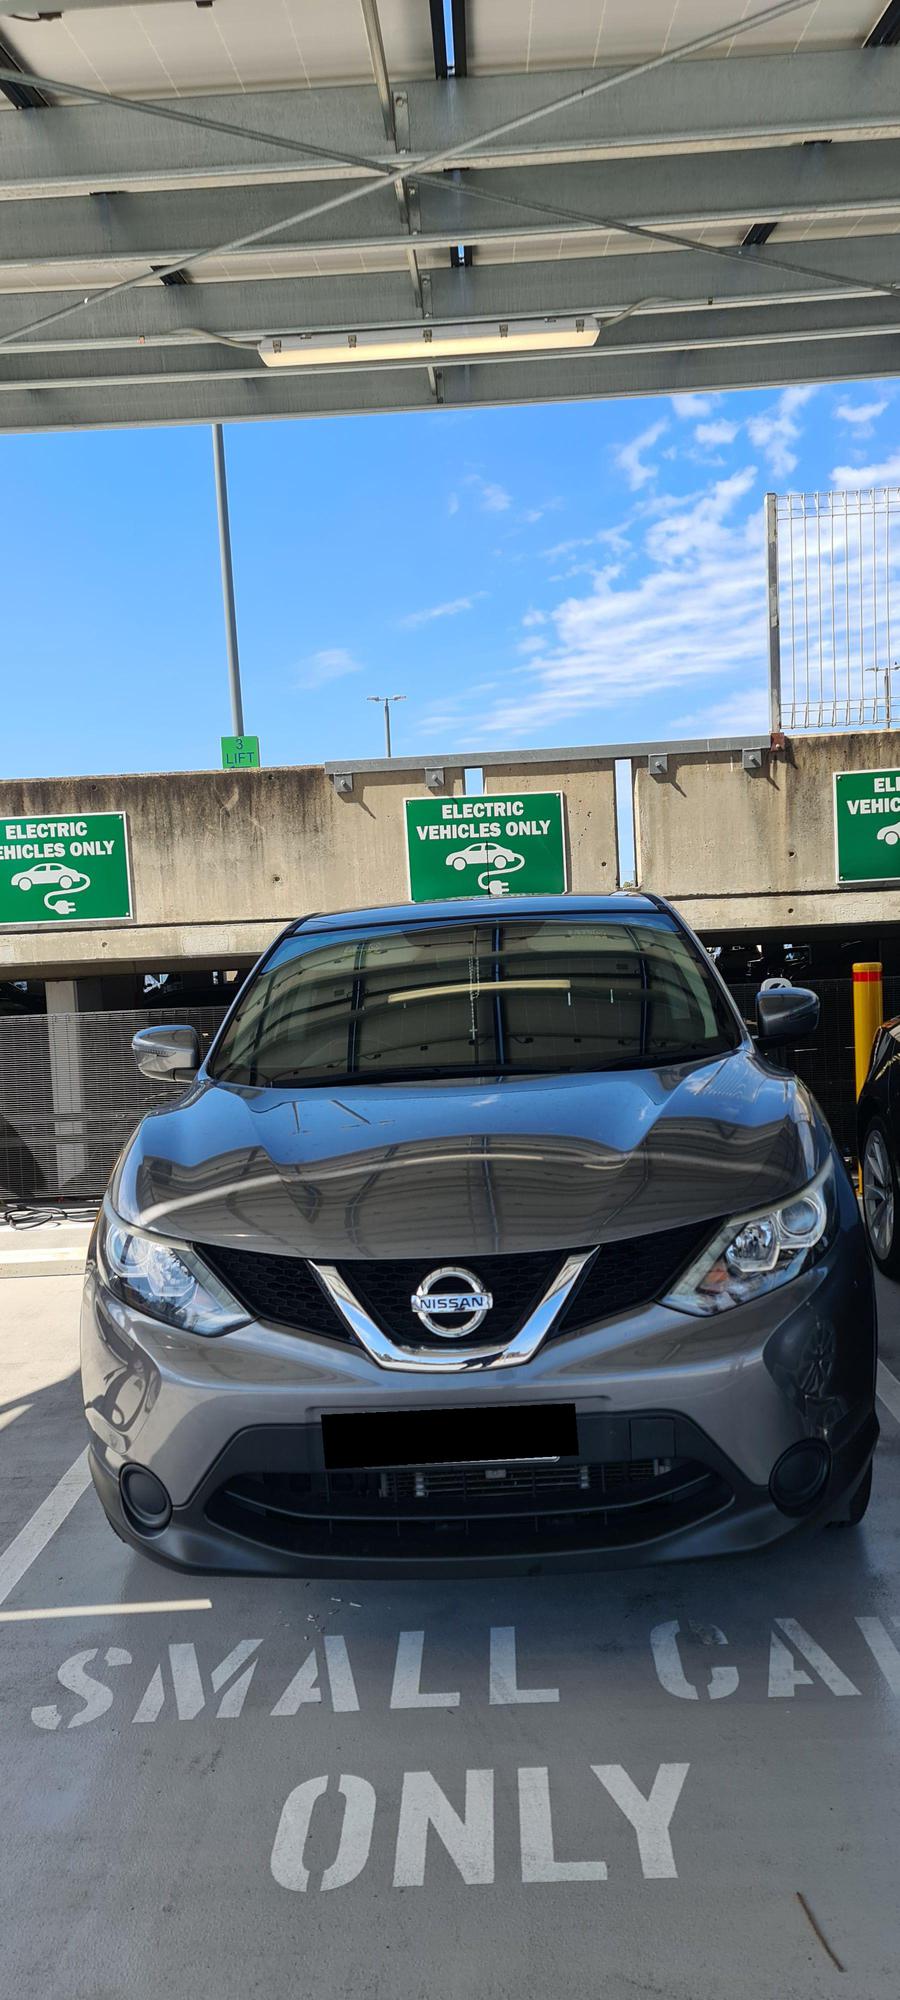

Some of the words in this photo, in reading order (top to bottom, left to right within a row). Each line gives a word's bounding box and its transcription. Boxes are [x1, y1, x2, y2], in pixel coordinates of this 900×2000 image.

[236, 738, 243, 750] 3
[226, 752, 254, 764] LIFT
[442, 801, 524, 819] ELECTRIC
[5, 822, 88, 840] ELECTRIC
[416, 822, 501, 840] VEHICLES
[505, 820, 551, 836] ONLY
[69, 840, 115, 857] ONLY
[420, 1297, 483, 1309] NISSAN
[30, 1626, 560, 1731] SMALL
[270, 1763, 690, 1893] ONLY
